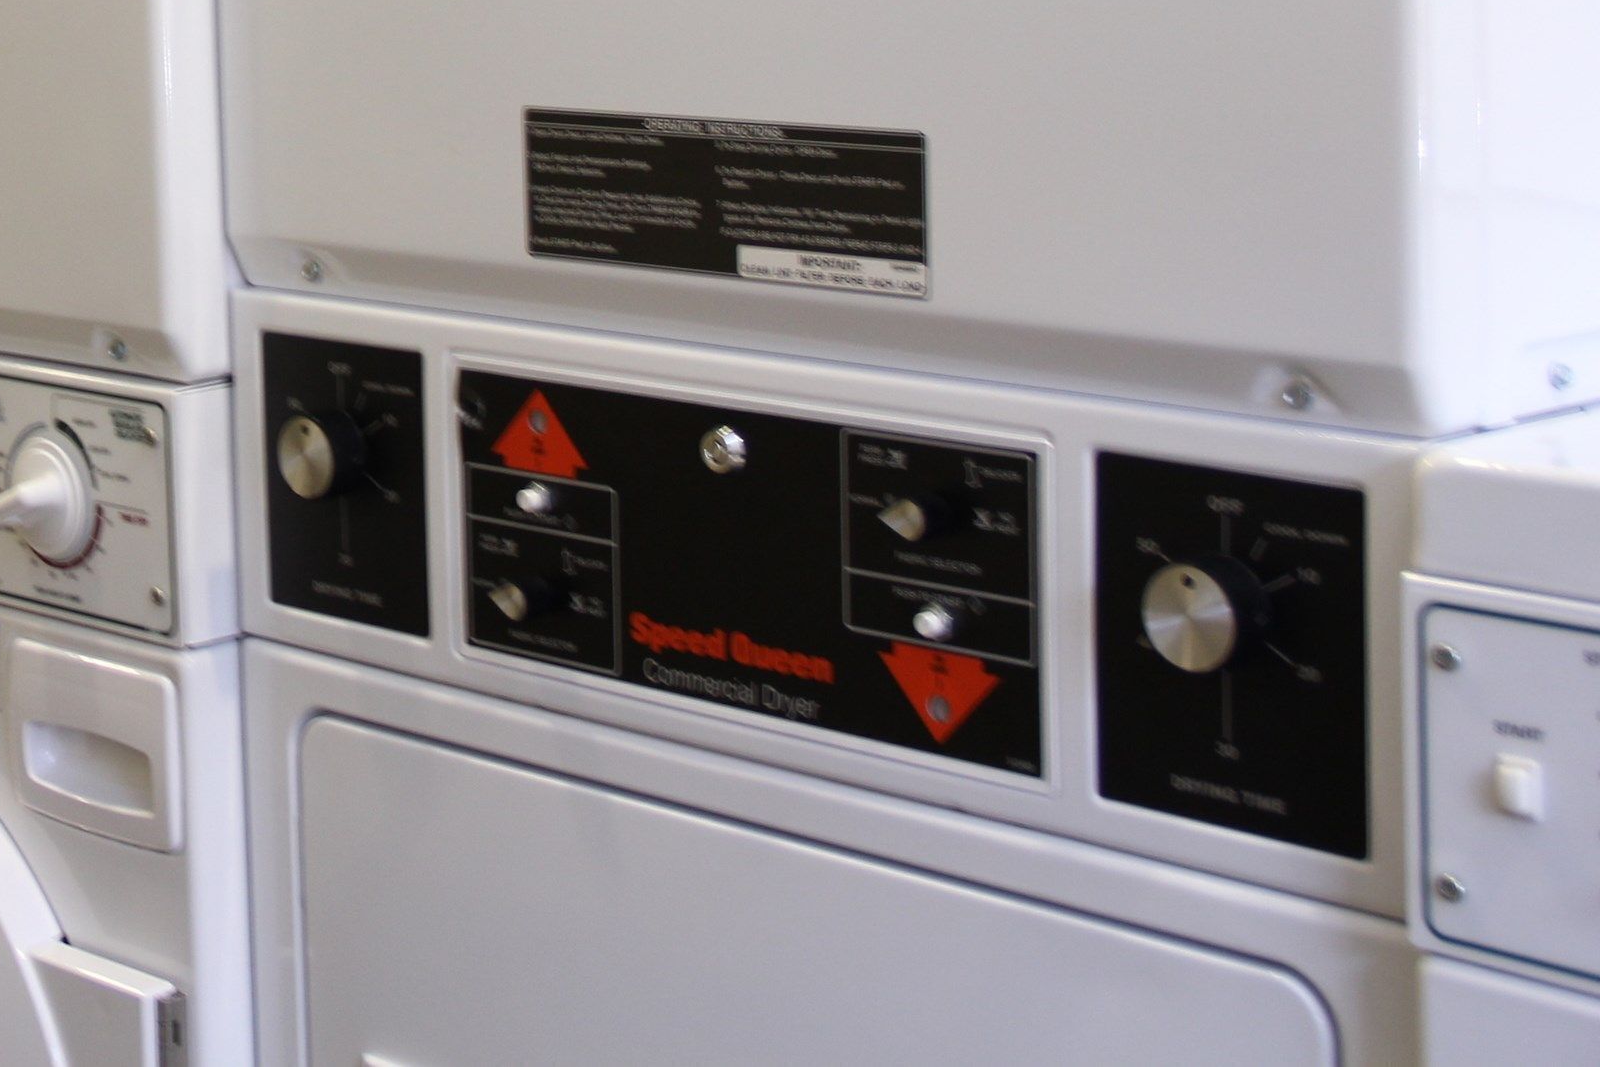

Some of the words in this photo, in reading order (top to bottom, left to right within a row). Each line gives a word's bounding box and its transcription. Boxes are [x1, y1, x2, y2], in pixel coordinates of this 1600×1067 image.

[643, 117, 701, 135] OPERATING
[703, 120, 784, 139] INSTRUCTIONS
[628, 611, 729, 662] Speed
[729, 630, 836, 684] Queen
[642, 657, 754, 705] Commercial
[761, 684, 820, 719] Dryer
